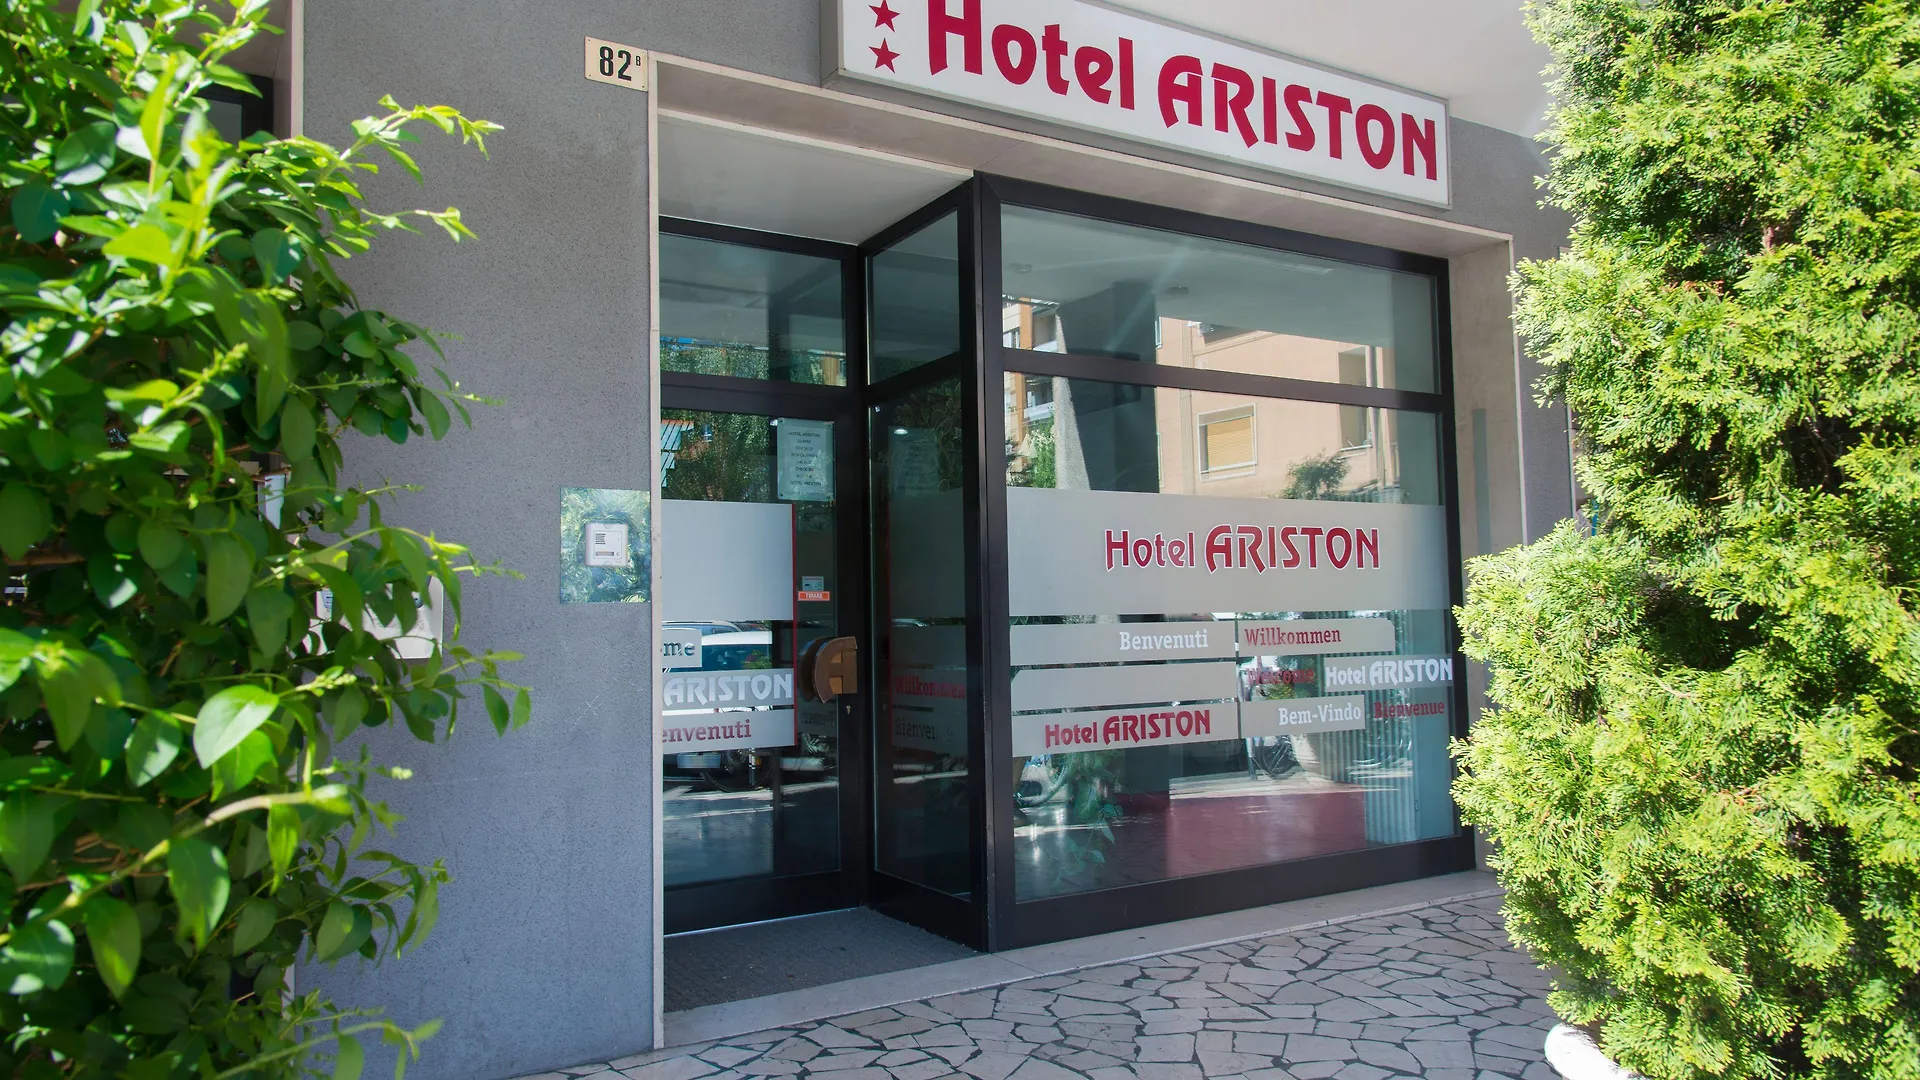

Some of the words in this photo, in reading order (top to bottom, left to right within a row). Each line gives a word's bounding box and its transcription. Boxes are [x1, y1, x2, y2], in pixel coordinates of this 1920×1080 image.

[599, 45, 632, 81] 82
[928, 0, 1135, 111] Hotel
[1157, 54, 1438, 181] ARISTON
[1104, 528, 1196, 572] Hotel
[1204, 523, 1381, 575] ARISTON
[1119, 629, 1209, 652] Benvenuti
[1244, 626, 1342, 647] Willkommen
[1246, 667, 1315, 686] Welcome
[1324, 665, 1367, 689] Hotel
[1369, 658, 1453, 687] ARISTON
[663, 673, 793, 708] ARISTON
[1278, 701, 1362, 727] Bem-Vindo
[1373, 701, 1445, 720] Bienvenue
[1045, 720, 1098, 749] Hotel
[1103, 709, 1211, 745] ARISTON
